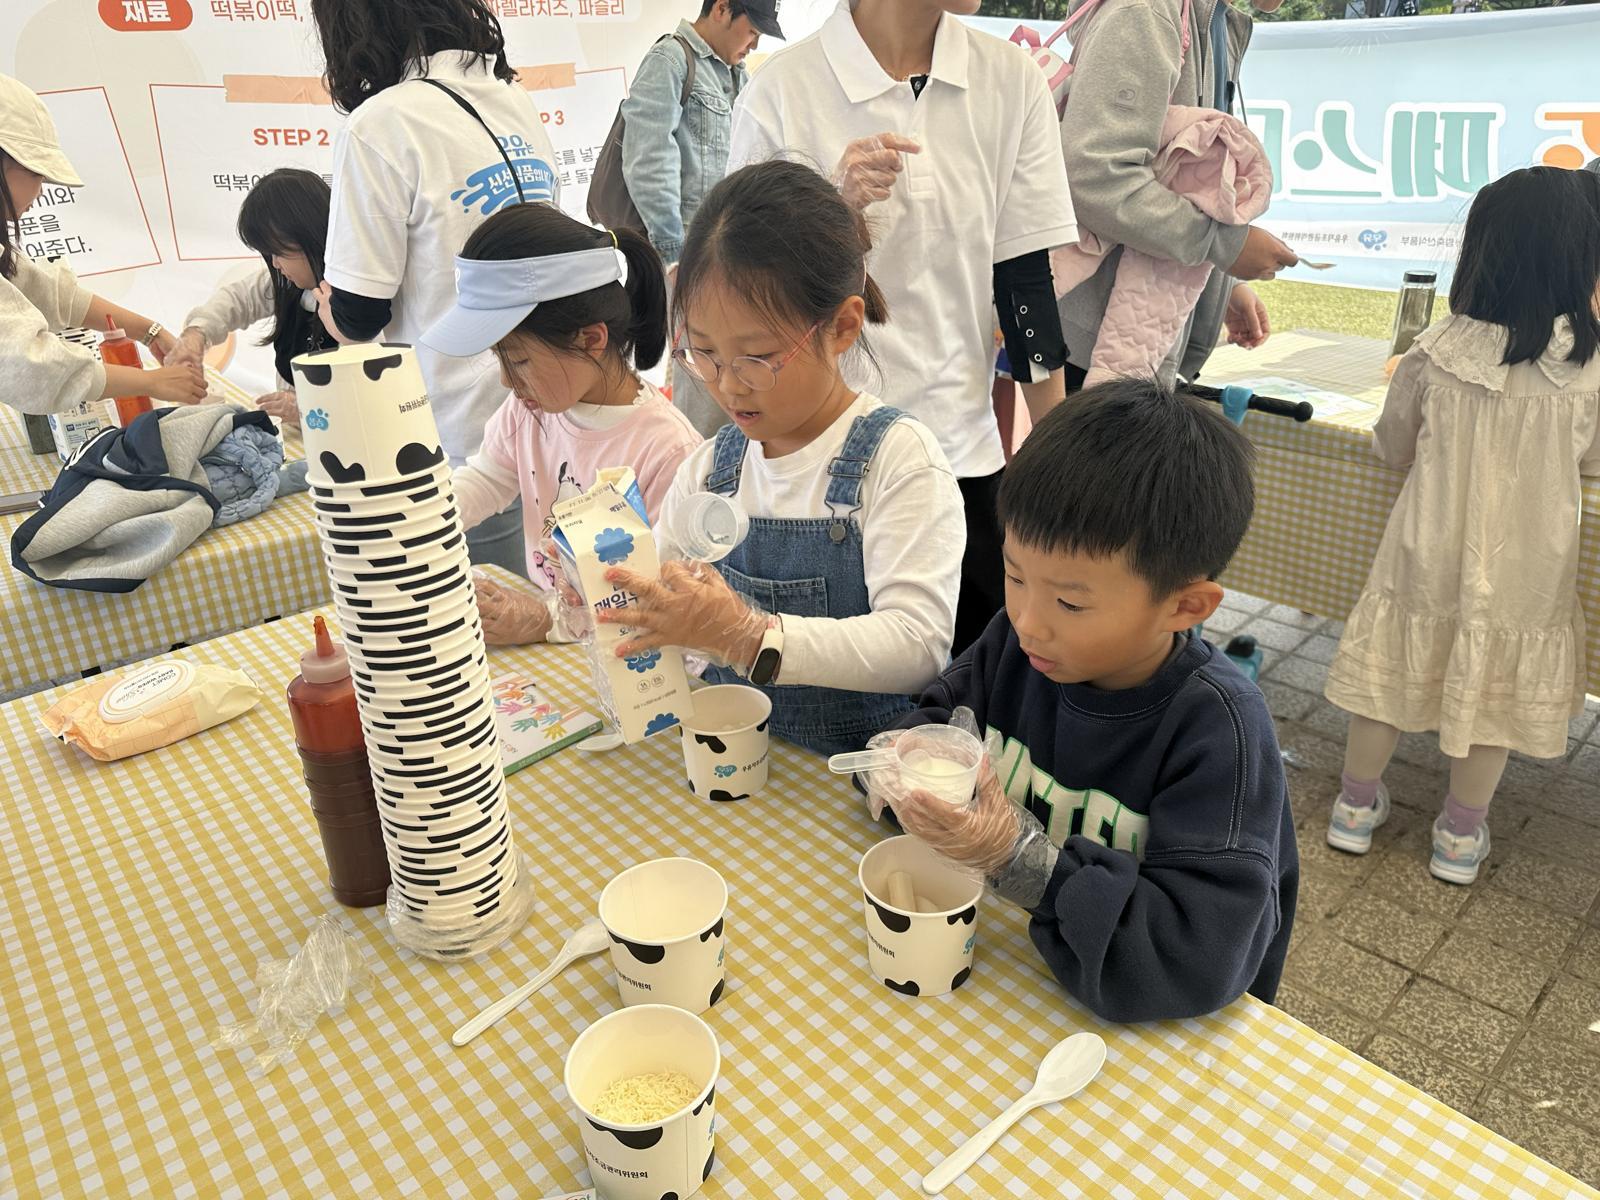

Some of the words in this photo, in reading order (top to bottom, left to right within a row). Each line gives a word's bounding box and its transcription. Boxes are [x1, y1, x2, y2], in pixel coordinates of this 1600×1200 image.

[122, 1, 171, 23] 재료
[210, 0, 304, 22] 떡볶이떡,
[578, 0, 626, 16] 파슬리
[554, 110, 565, 126] 3
[253, 128, 312, 146] STEP
[316, 129, 330, 146] 2
